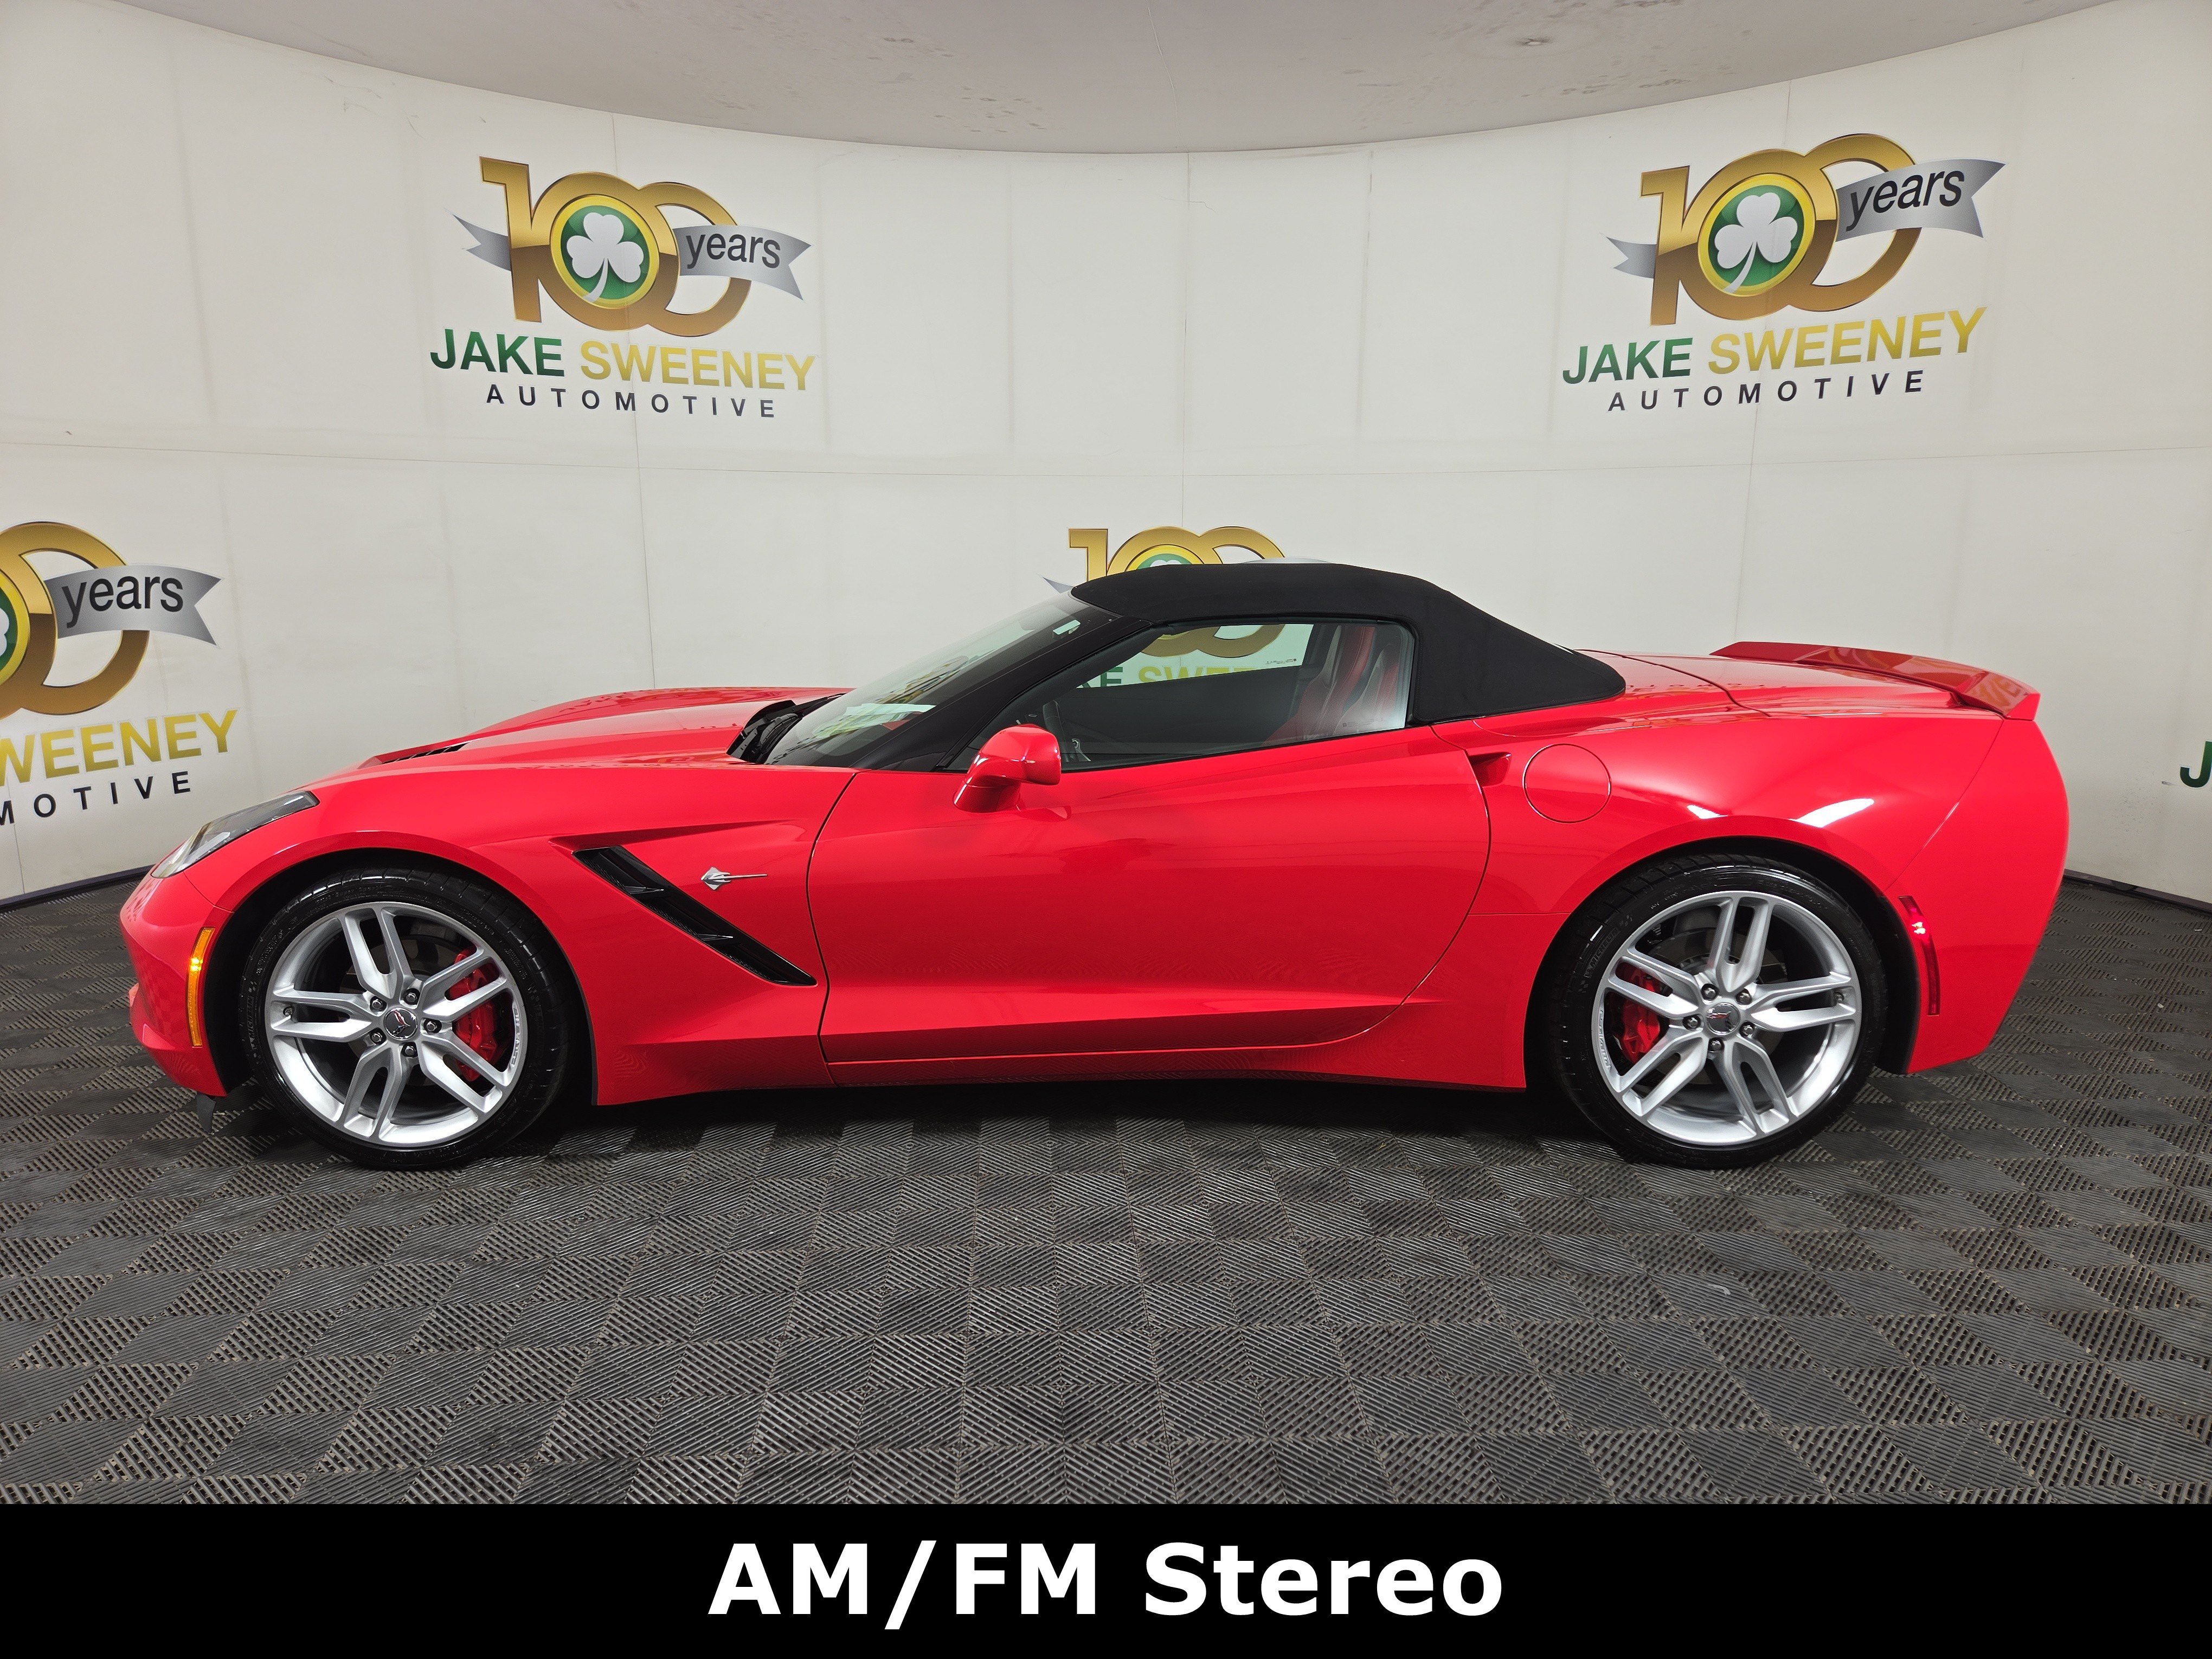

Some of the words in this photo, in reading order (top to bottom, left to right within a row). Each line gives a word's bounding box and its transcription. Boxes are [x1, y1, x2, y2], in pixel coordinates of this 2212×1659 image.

[1639, 133, 1922, 326] 100
[1845, 169, 1965, 232] years
[479, 156, 752, 337] 100
[685, 232, 782, 269] years
[430, 329, 565, 377] JAKE
[580, 340, 816, 390] SWEENEY
[1562, 337, 1693, 384] JAKE
[1708, 306, 1988, 375] SWEENEY
[486, 384, 775, 417] AUTOMOTIVE
[1608, 370, 1924, 412] AUTOMOTIVE
[61, 575, 184, 628] years
